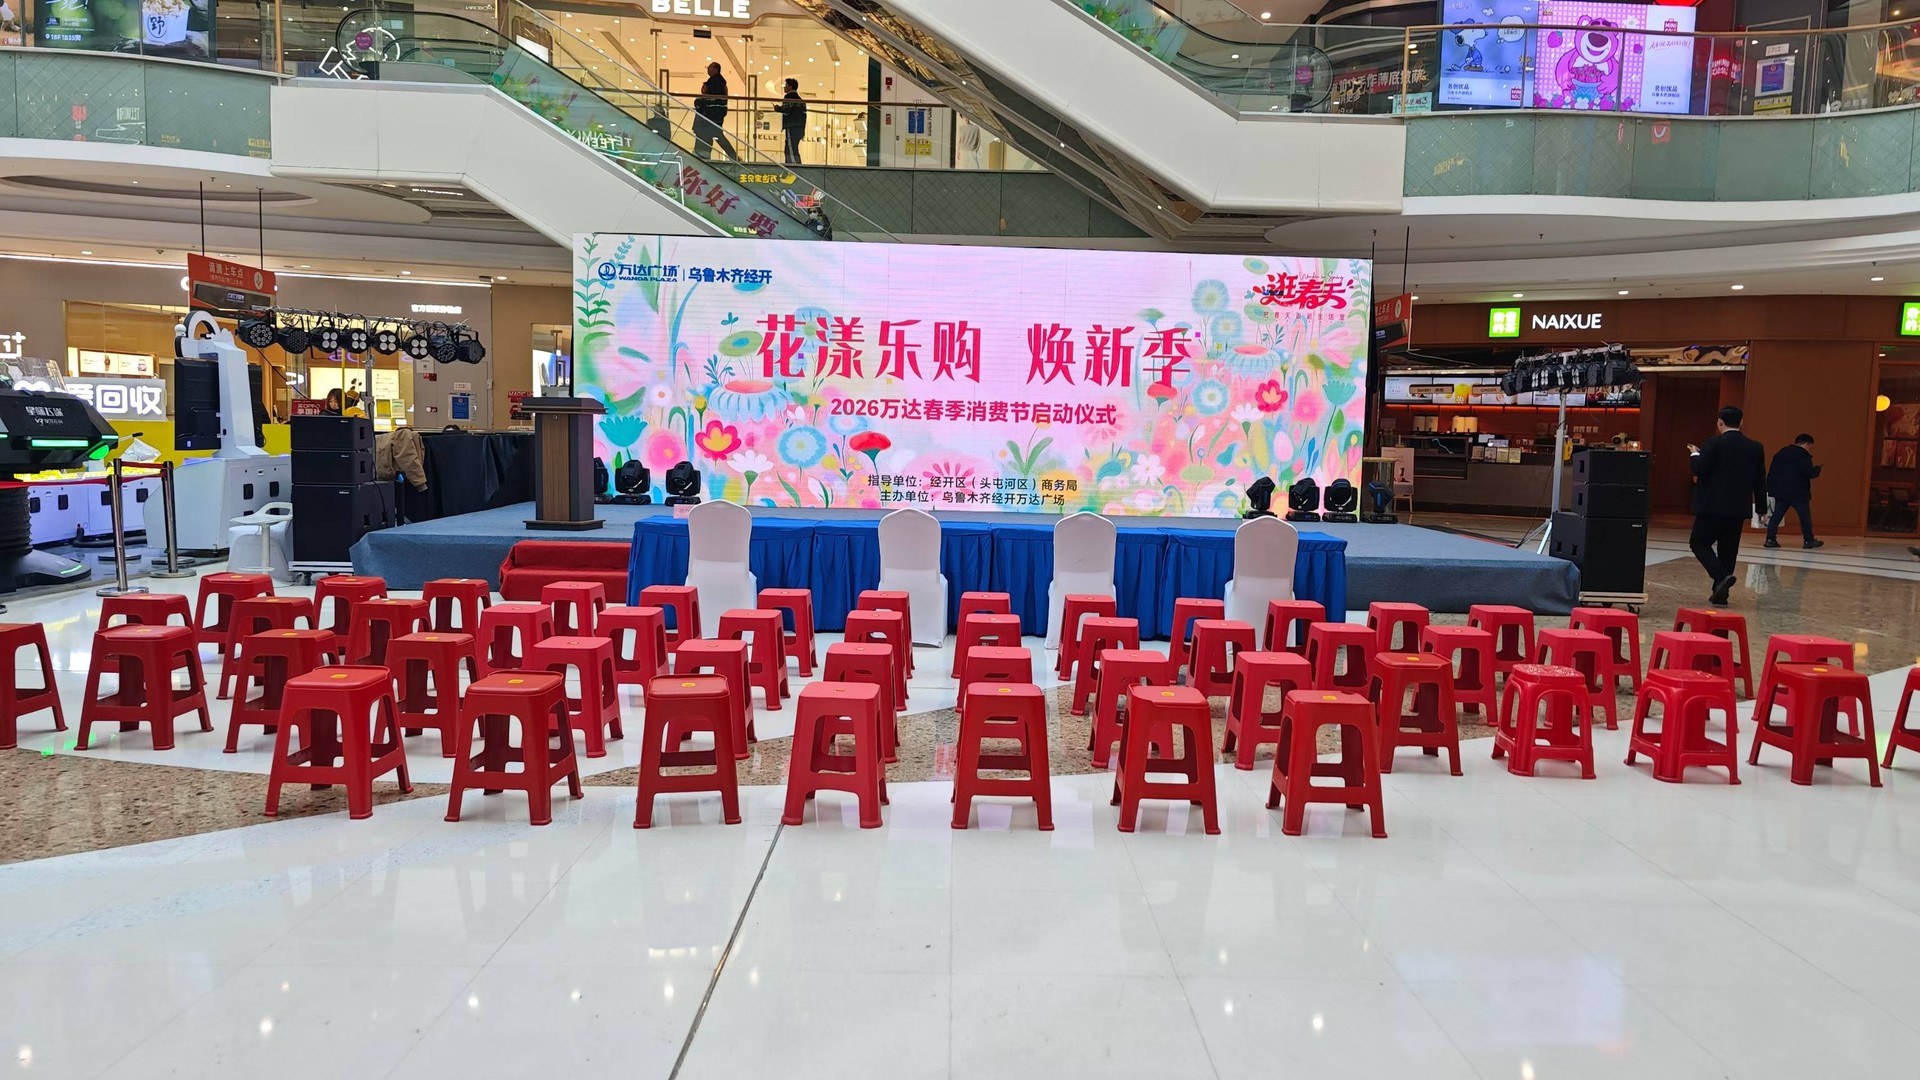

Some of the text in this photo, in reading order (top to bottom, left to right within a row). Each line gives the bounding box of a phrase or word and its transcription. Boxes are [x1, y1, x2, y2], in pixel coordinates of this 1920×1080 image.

[652, 0, 750, 18] BELLE
[149, 16, 165, 35] 野
[209, 261, 244, 279] 滴滴上车点
[618, 264, 678, 277] 万达广场
[688, 267, 772, 284] 乌鲁木齐经开
[1260, 272, 1347, 309] 逛春天
[1532, 313, 1602, 329] NAIXUE
[757, 314, 1193, 389] 花漾乐购 焕新季
[830, 398, 1117, 426] 2026万达春季消费节启动仪式
[867, 474, 1078, 492] 指导单位：经开区（头屯河区）商务局
[880, 490, 1065, 507] 主办单位：乌鲁木齐经开万达广场
